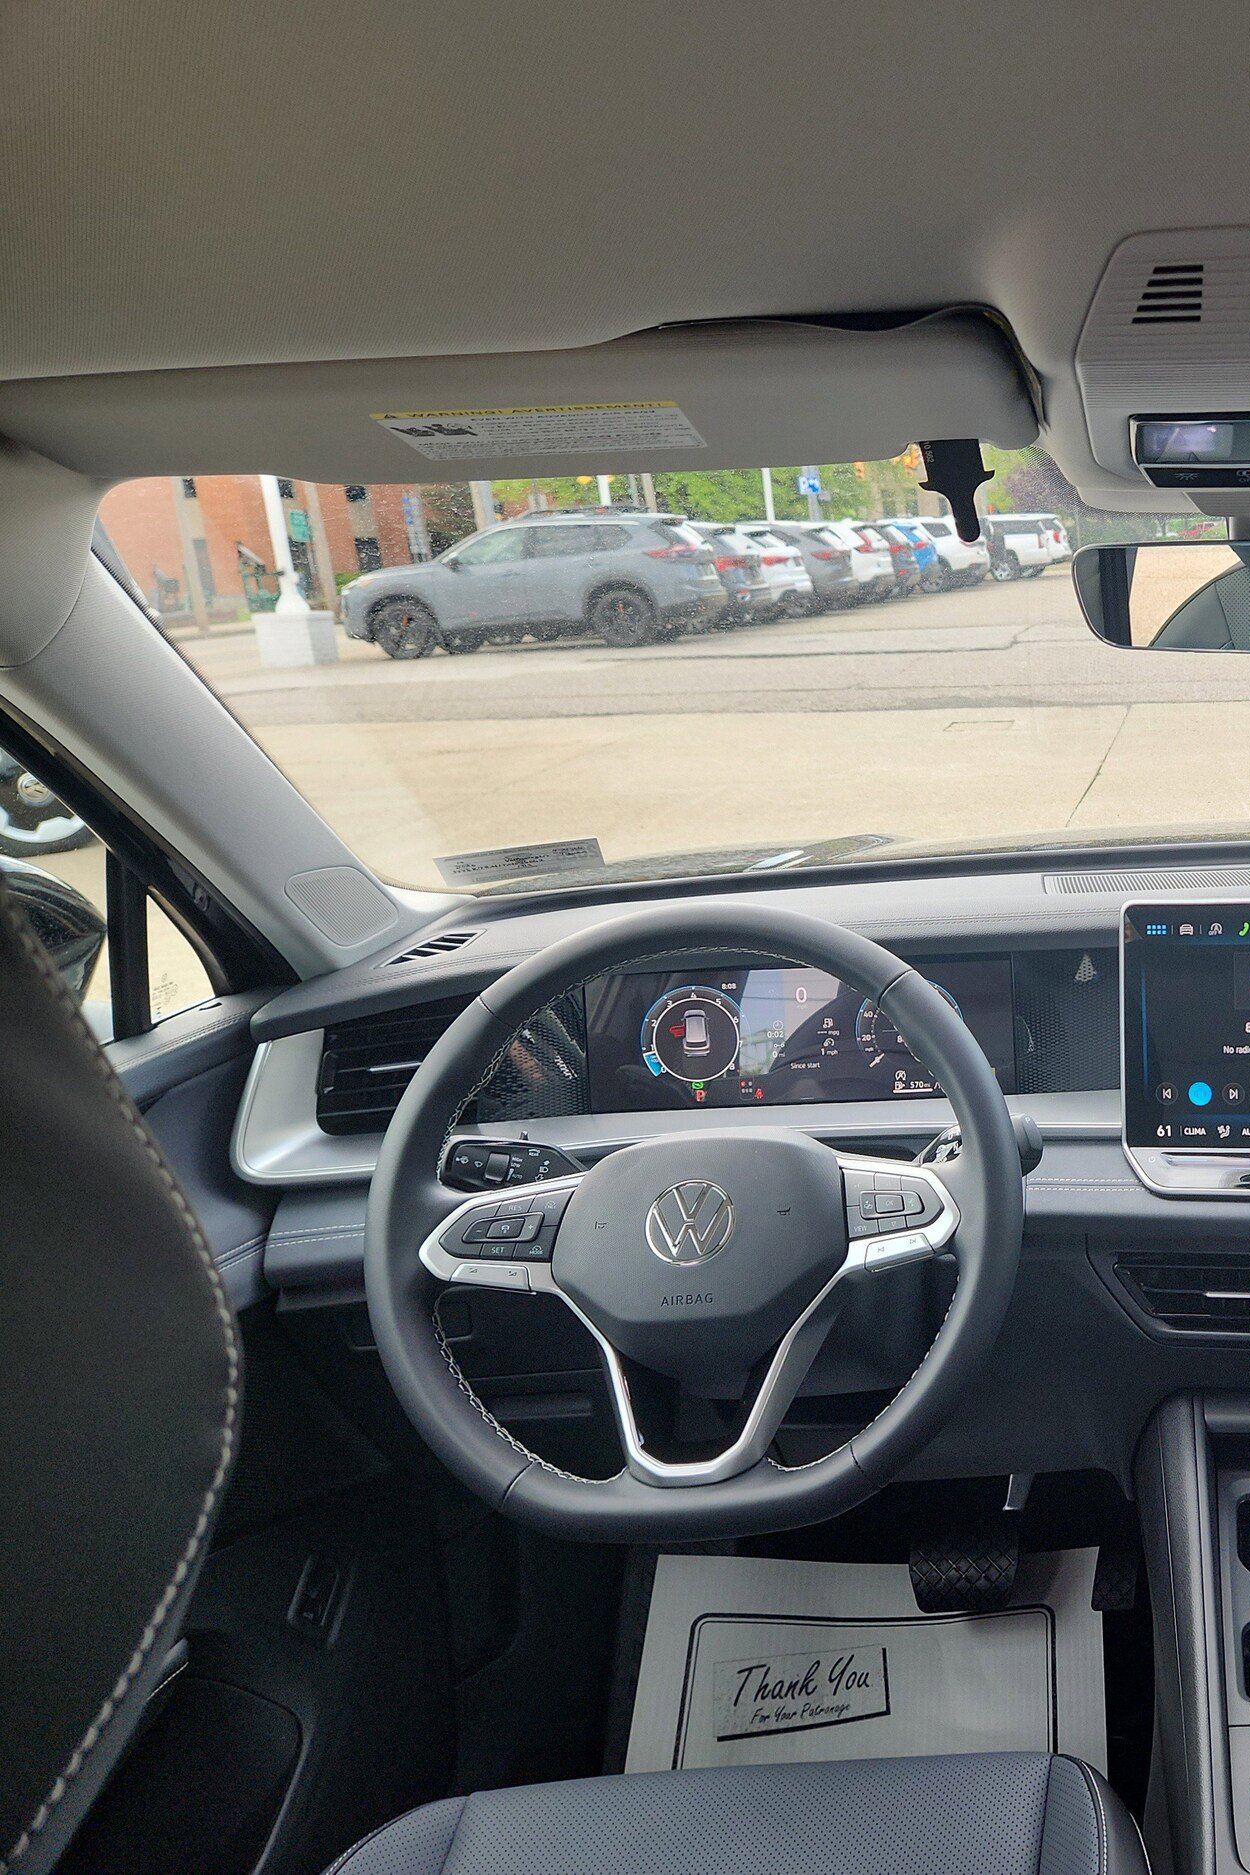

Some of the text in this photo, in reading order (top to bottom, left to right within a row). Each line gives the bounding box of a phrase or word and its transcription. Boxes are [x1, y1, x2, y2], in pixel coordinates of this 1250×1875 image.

[796, 987, 807, 1004] 0
[861, 1034, 872, 1042] 20
[826, 1049, 839, 1057] mph
[1223, 1045, 1234, 1054] No
[1156, 1125, 1172, 1138] 61
[1184, 1127, 1207, 1136] CLIMA
[660, 1293, 714, 1307] AIRBAG
[733, 1654, 870, 1707] Thank You
[751, 1702, 850, 1724] For Your Patronage
